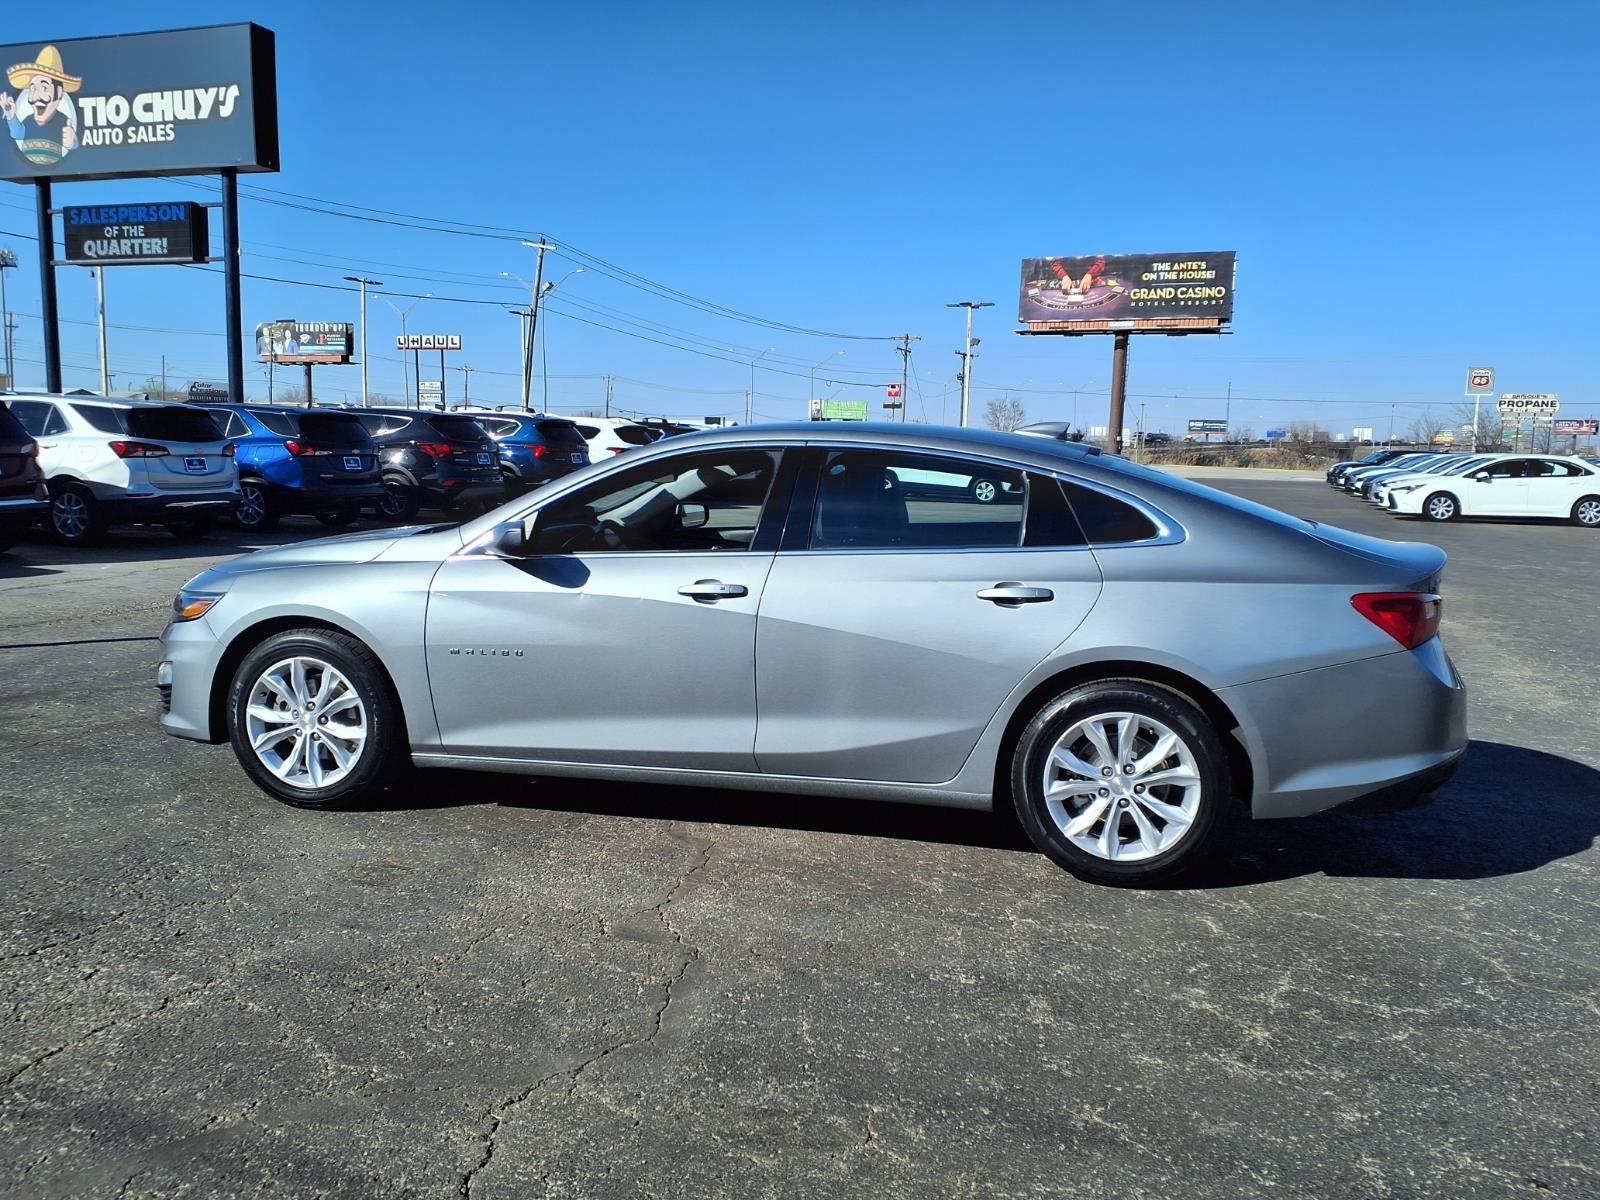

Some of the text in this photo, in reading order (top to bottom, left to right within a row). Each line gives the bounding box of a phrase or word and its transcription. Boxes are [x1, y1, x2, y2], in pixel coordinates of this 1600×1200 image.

[78, 84, 240, 127] TIO CHUY'S
[81, 124, 175, 146] AUTO SALES
[70, 205, 185, 225] SALESPERSON
[104, 225, 145, 238] OF THE
[83, 237, 168, 258] QUARTER!
[1152, 261, 1207, 271] THE ANTE'S
[1142, 270, 1216, 281] ON THE HOUSE!
[1130, 286, 1226, 300] GRAND CASINO
[1473, 376, 1488, 385] 66
[1498, 400, 1558, 408] PROPANE
[449, 648, 524, 657] MALIBU
